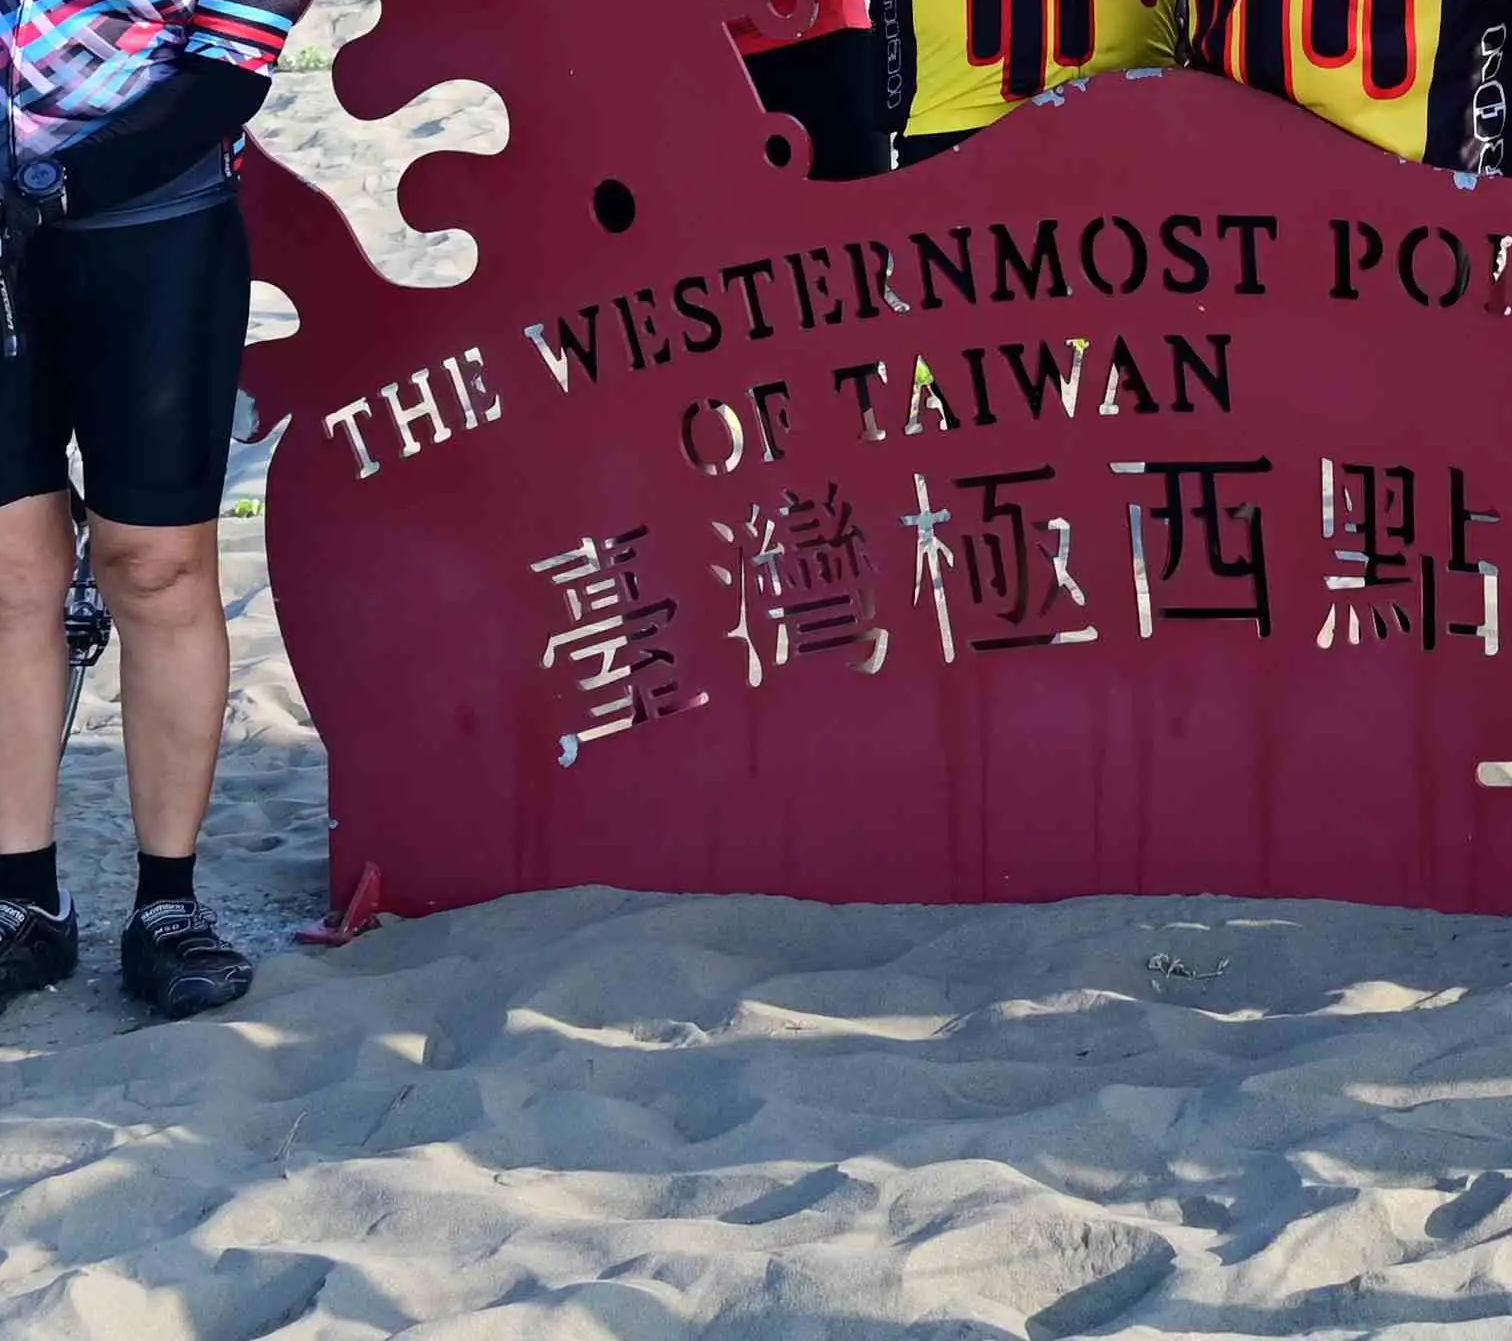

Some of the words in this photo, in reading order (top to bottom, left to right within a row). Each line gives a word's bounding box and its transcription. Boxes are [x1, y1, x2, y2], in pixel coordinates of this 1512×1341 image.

[322, 345, 505, 480] THE
[523, 213, 1278, 393] WESTERNMOST
[679, 378, 793, 477] OF
[832, 333, 1232, 444] TAIWAN
[528, 455, 1500, 749] 臺灣極西點
